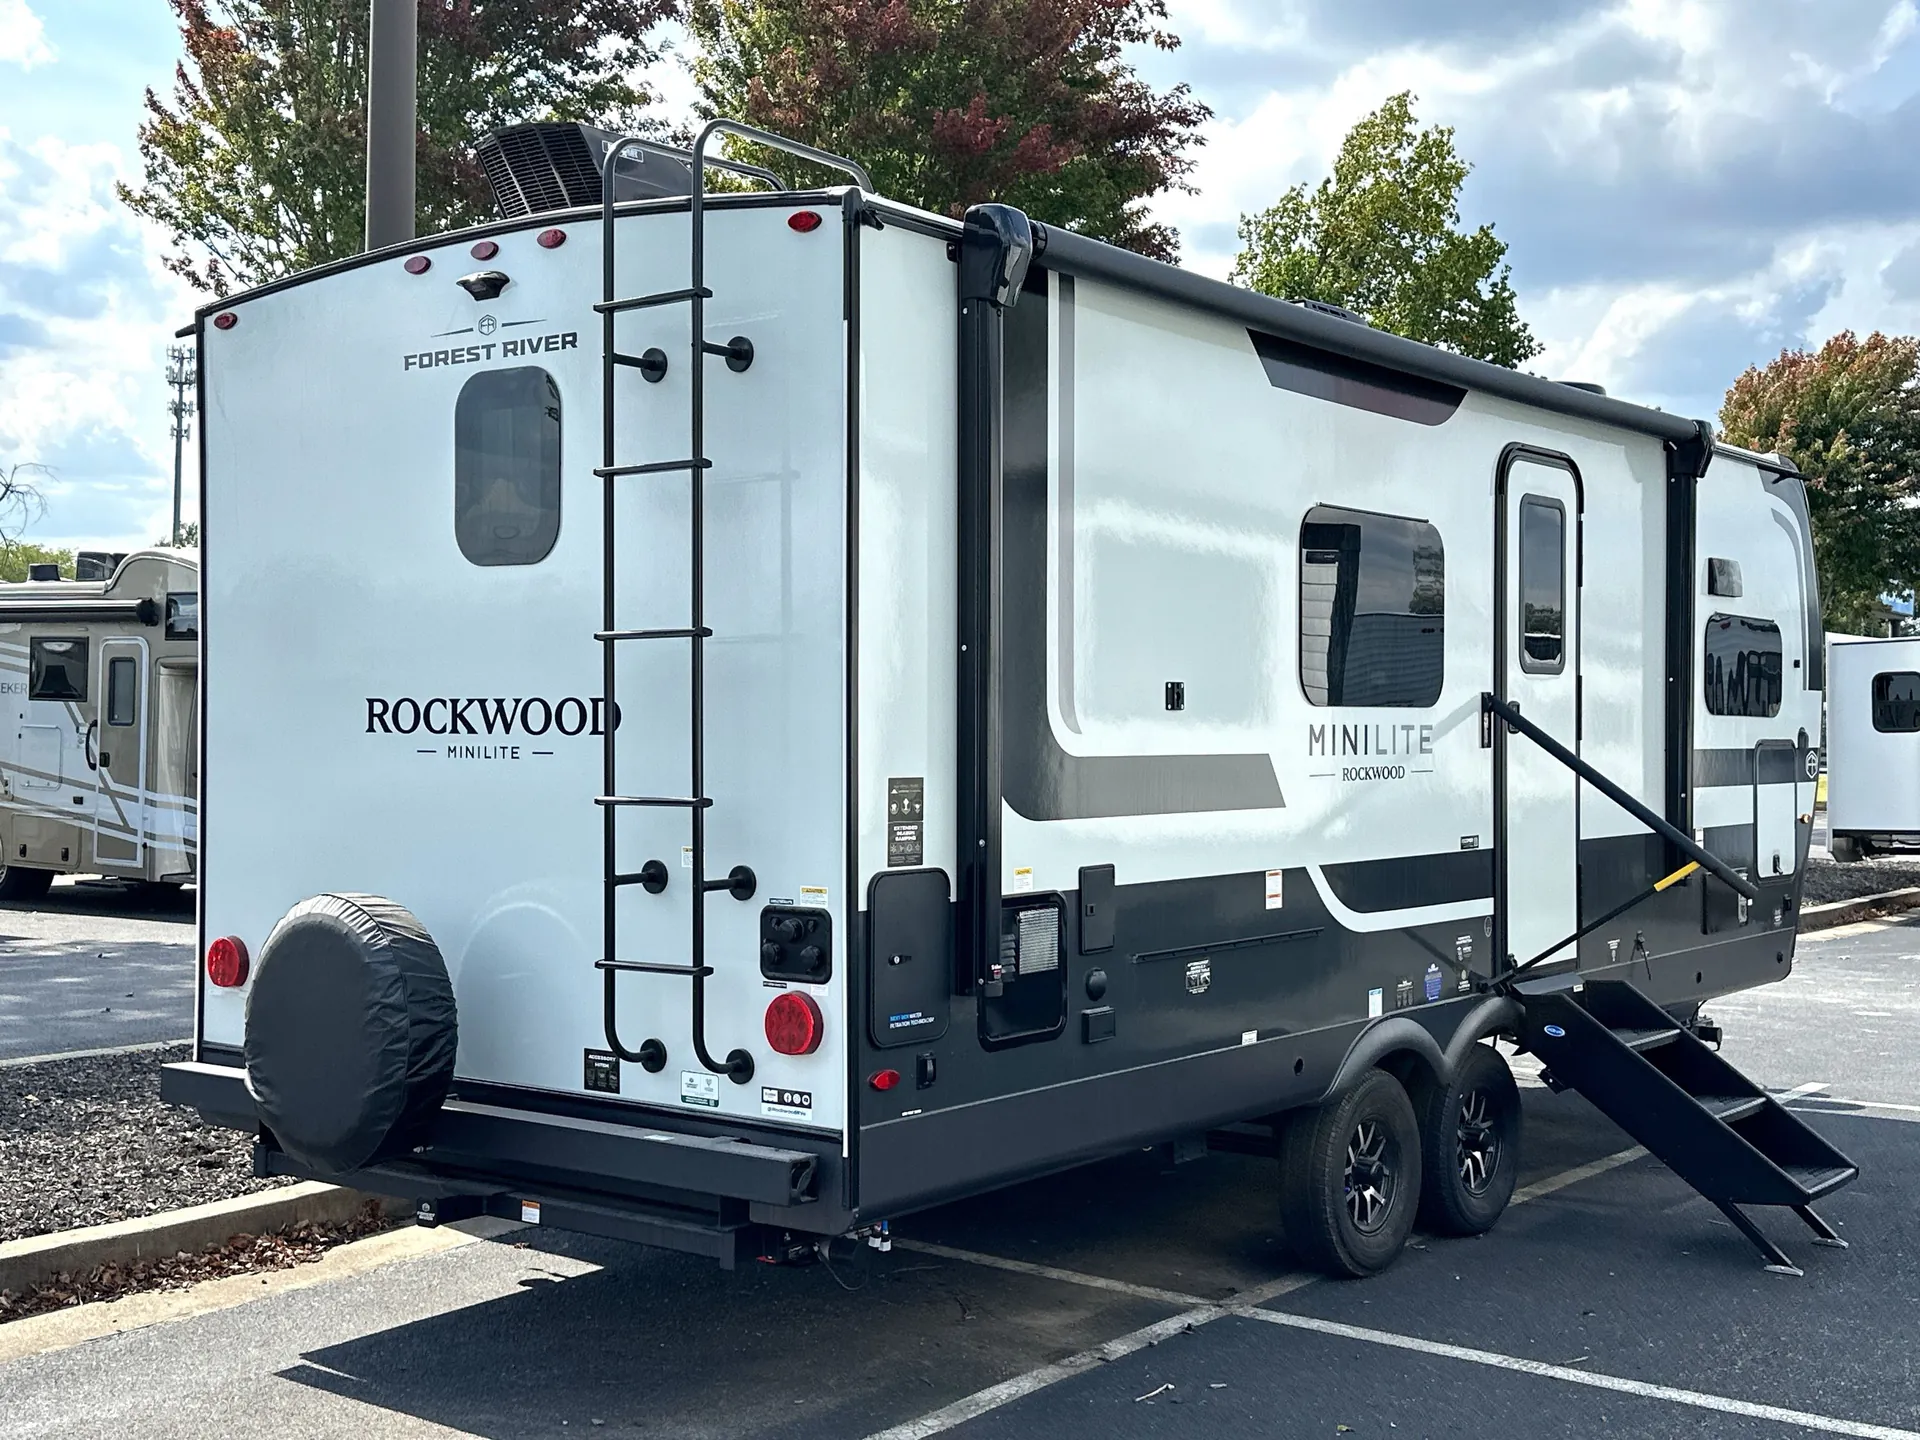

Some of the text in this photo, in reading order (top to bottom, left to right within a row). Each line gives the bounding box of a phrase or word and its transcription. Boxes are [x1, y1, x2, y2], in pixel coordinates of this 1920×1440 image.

[403, 331, 578, 371] FOREST RIVER
[365, 697, 622, 736] ROCKWOOD
[1309, 724, 1433, 756] MINILITE
[447, 745, 520, 760] MINILITE
[1342, 765, 1405, 781] ROCKWOOD
[588, 1054, 616, 1062] ACCESSORY
